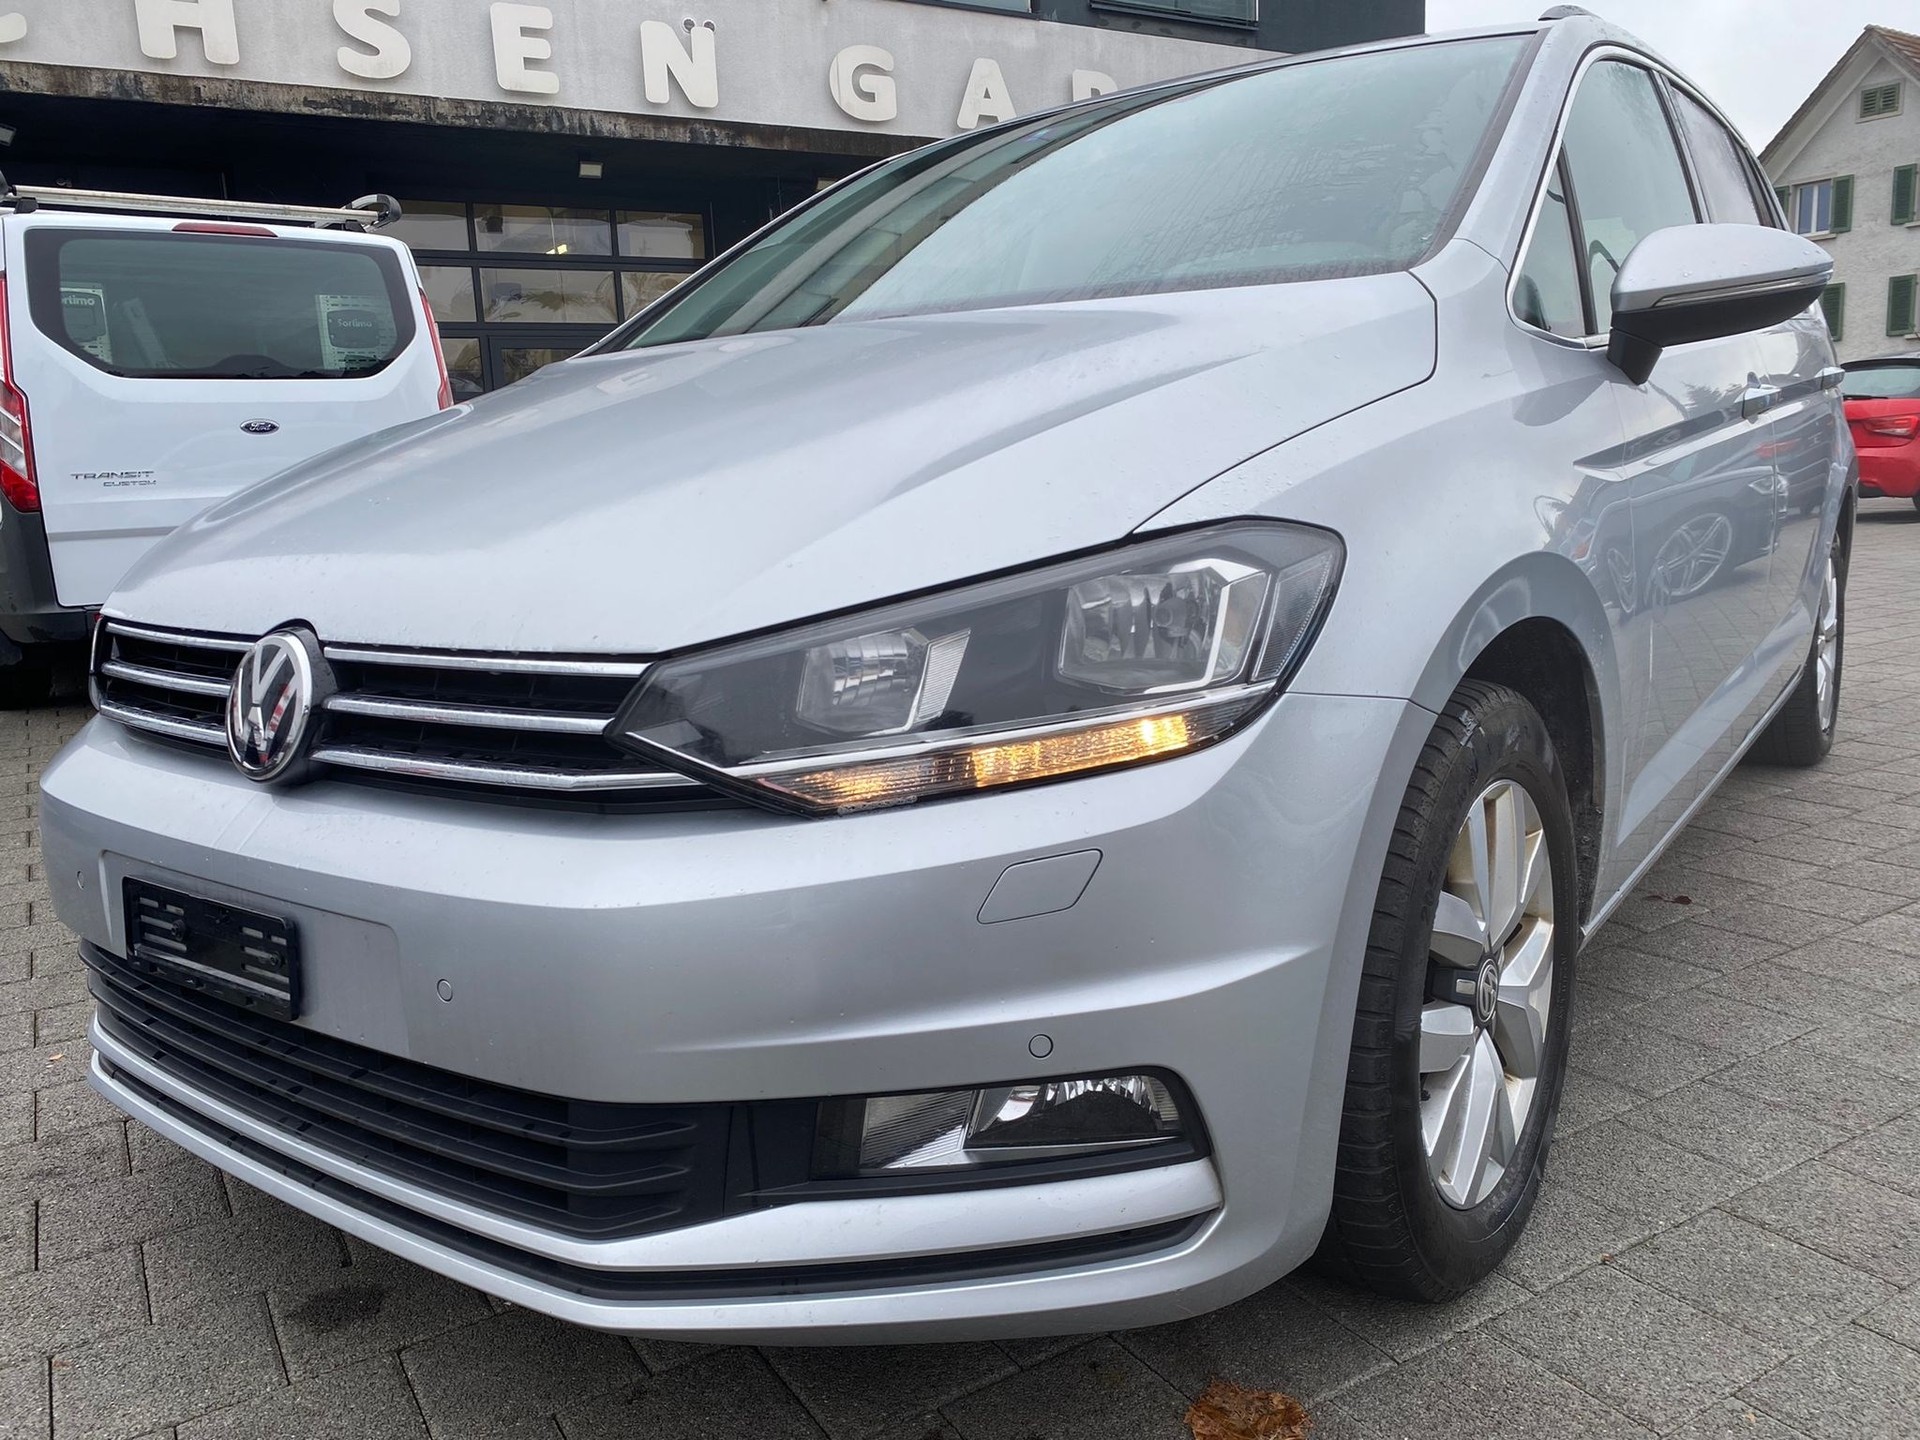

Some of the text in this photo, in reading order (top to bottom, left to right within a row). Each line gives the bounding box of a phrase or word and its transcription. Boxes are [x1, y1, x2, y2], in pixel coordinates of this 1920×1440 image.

[0, 0, 718, 108] HSEN
[246, 420, 274, 433] Ford
[70, 470, 154, 480] TRANSIT
[103, 479, 157, 487] CUSTOM
